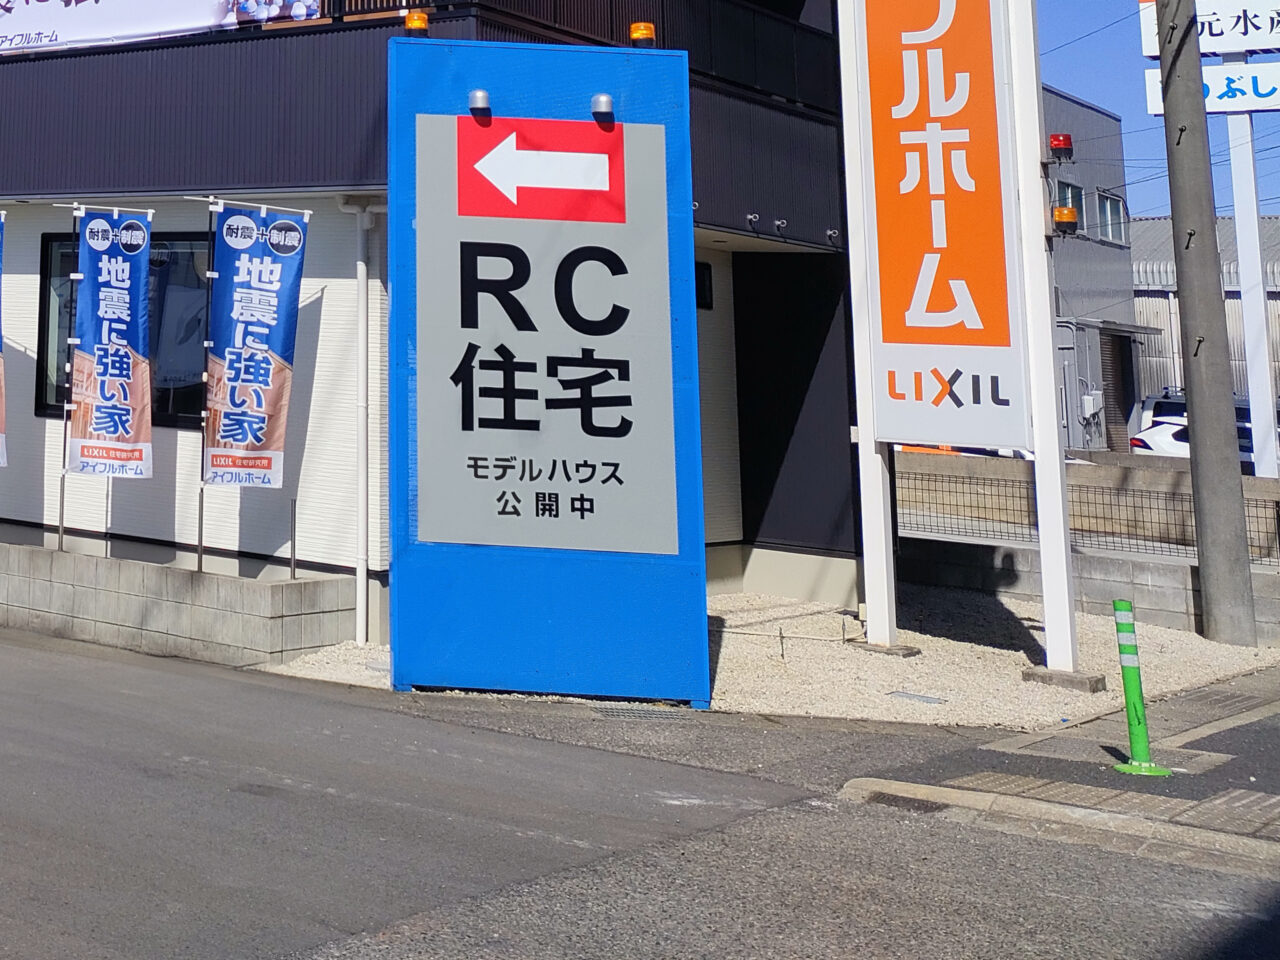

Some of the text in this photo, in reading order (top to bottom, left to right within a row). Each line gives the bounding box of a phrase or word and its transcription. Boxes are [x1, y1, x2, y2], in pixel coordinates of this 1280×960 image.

[459, 240, 631, 337] RC
[90, 254, 133, 437] 地震に強い家
[218, 253, 283, 446] 地震に強い家
[449, 342, 634, 439] 住宅
[887, 367, 1011, 409] LIXIL
[84, 448, 107, 457] LIXIL
[213, 457, 233, 465] LIXIL
[79, 461, 143, 476] アイフルホーム
[211, 471, 272, 485] アイフルホーム
[466, 455, 625, 486] モデルハウス
[496, 491, 595, 520] 公開中
